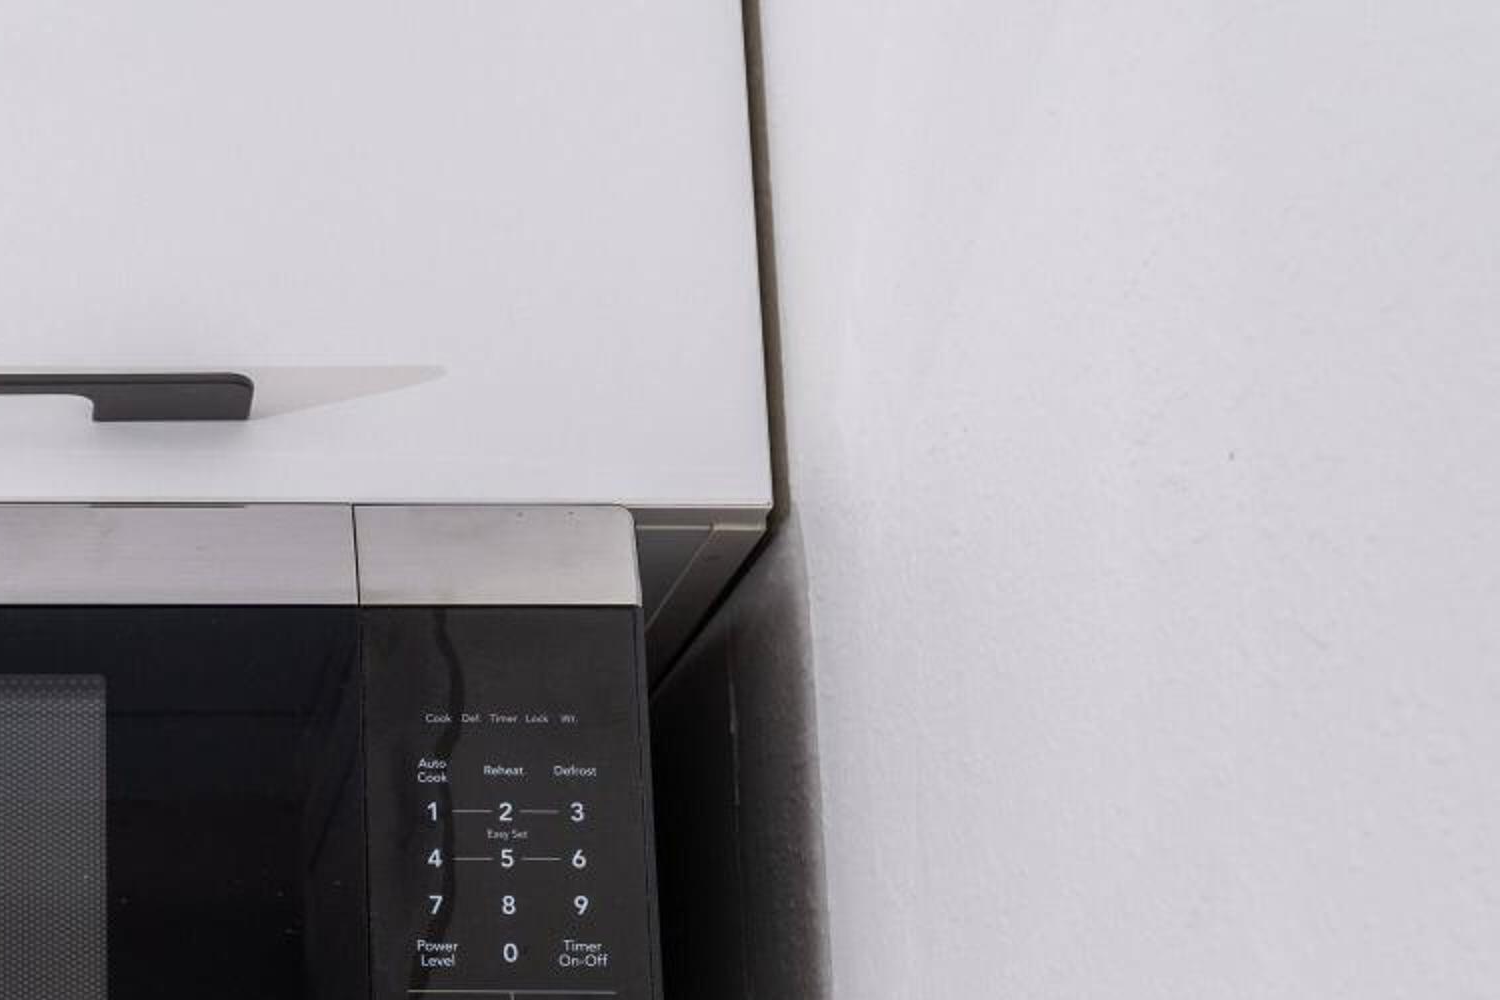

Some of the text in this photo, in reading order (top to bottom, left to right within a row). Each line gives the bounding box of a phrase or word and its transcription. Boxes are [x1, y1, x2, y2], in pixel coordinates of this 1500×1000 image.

[424, 714, 452, 724] Cook
[489, 714, 518, 724] Timer
[525, 715, 549, 724] Lock
[417, 758, 447, 769] Auto
[417, 772, 448, 783] Cook
[483, 766, 524, 777] Reheat
[553, 765, 597, 777] Defrost
[427, 802, 585, 822] 1 2 3
[486, 829, 528, 841] Easy Set
[427, 849, 587, 869] 4 5 6
[429, 896, 589, 915] 7 8 9
[416, 940, 459, 953] Power
[563, 940, 602, 953] Timer
[503, 944, 519, 963] 0
[421, 954, 456, 967] Level
[558, 954, 609, 967] On-Off
